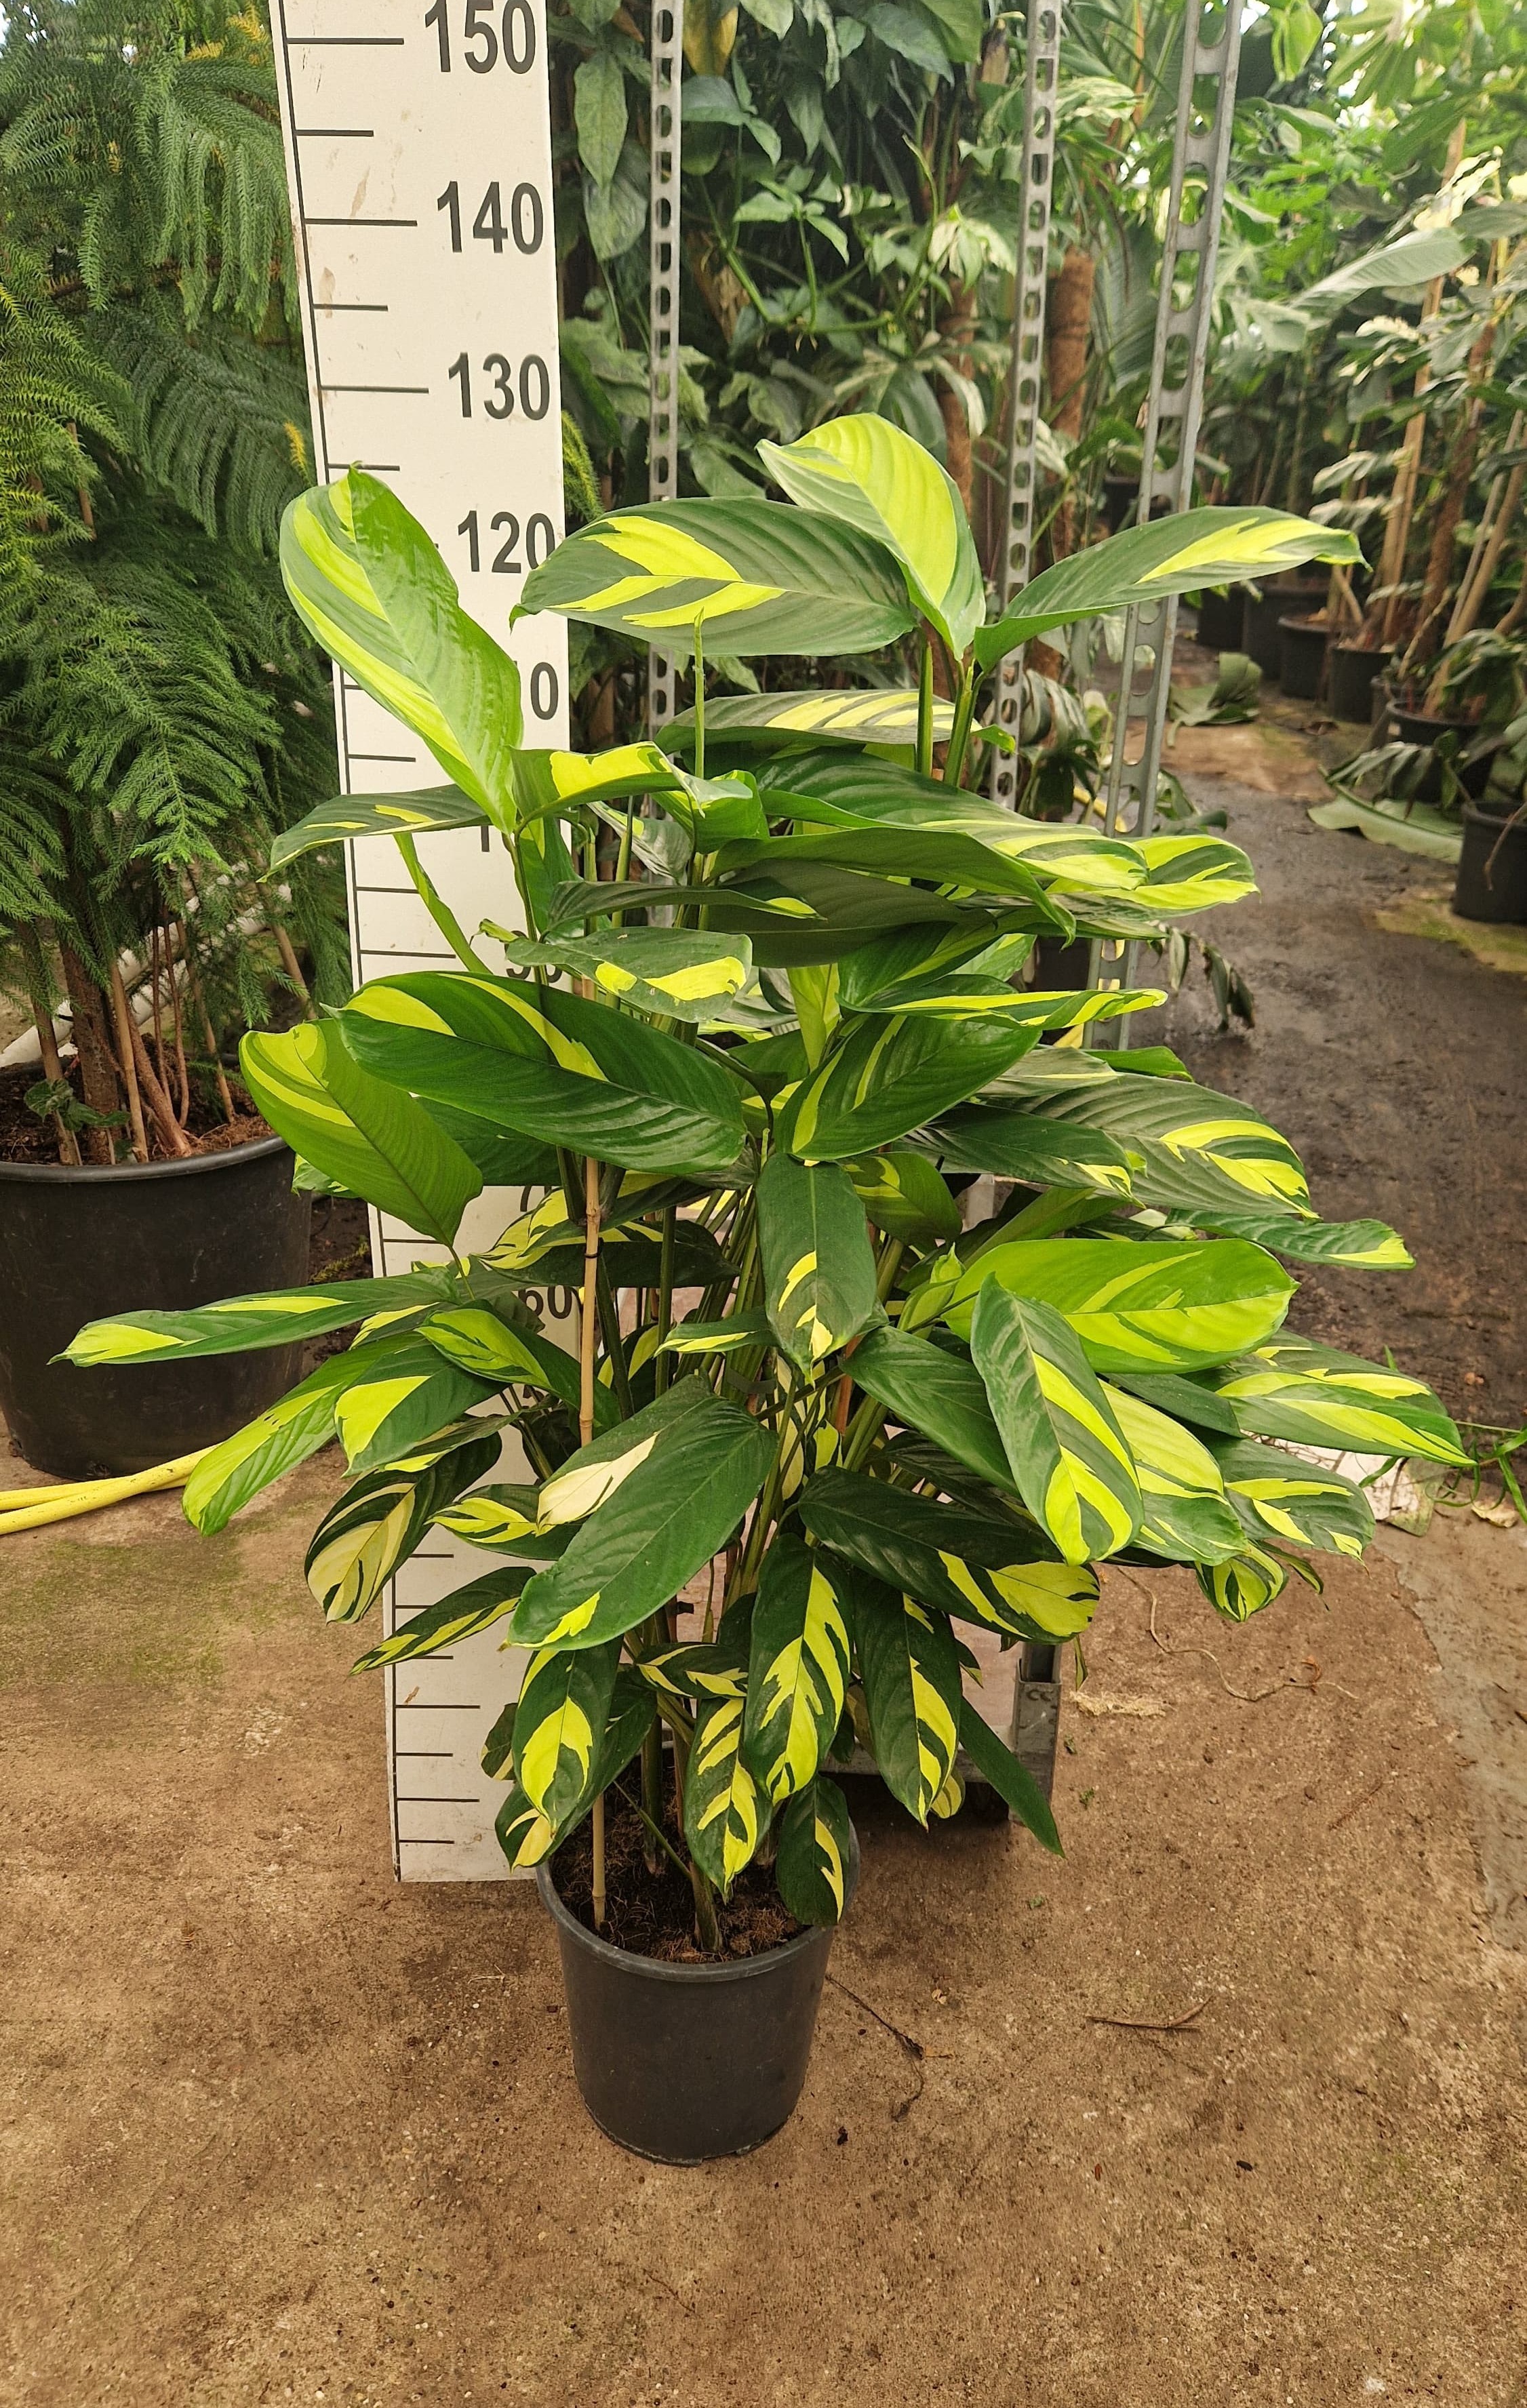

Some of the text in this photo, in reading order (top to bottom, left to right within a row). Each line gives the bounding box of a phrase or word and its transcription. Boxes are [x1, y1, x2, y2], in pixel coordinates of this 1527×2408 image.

[424, 0, 536, 74] 150
[437, 181, 543, 255] 140
[448, 352, 550, 421] 130
[458, 510, 556, 574] 120
